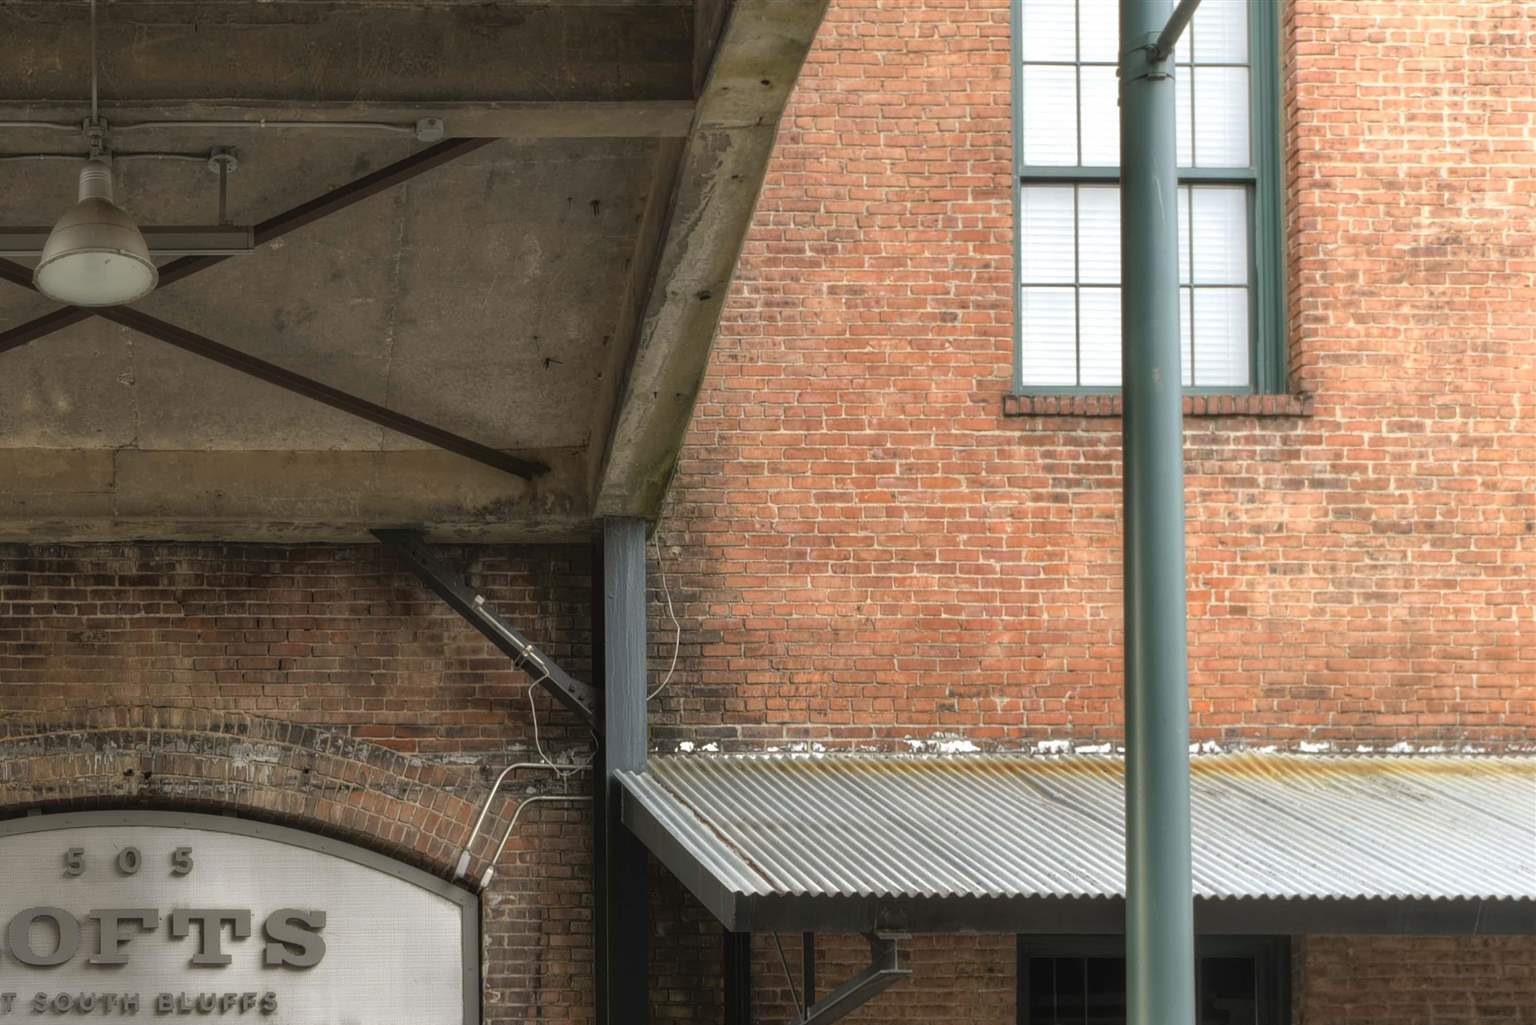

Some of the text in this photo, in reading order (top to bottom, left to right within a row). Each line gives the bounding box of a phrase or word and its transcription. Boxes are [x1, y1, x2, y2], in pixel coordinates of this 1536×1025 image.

[64, 846, 195, 875] 505
[32, 992, 140, 1015] SOUTH
[156, 991, 278, 1016] BLUFFS
